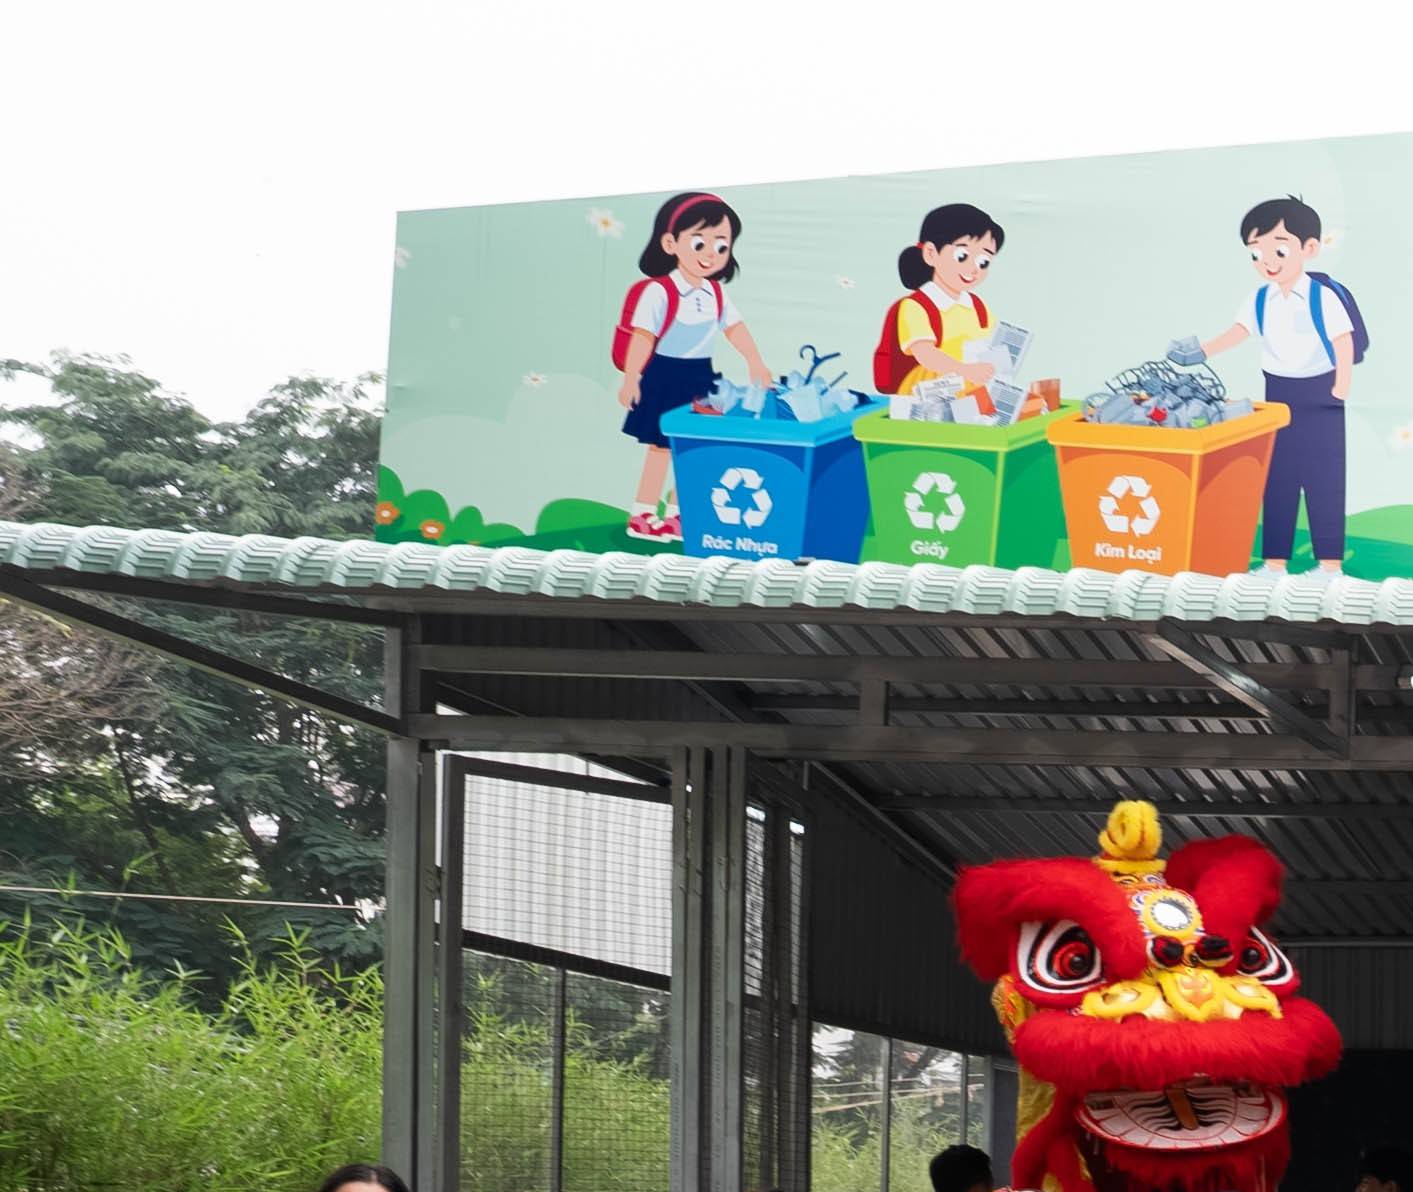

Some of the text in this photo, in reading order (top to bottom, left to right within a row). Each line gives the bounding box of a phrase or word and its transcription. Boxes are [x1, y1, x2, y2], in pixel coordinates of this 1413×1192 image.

[702, 534, 778, 557] Rác Nhựa
[910, 540, 949, 560] Giấy
[1095, 543, 1162, 563] Kim Loại
